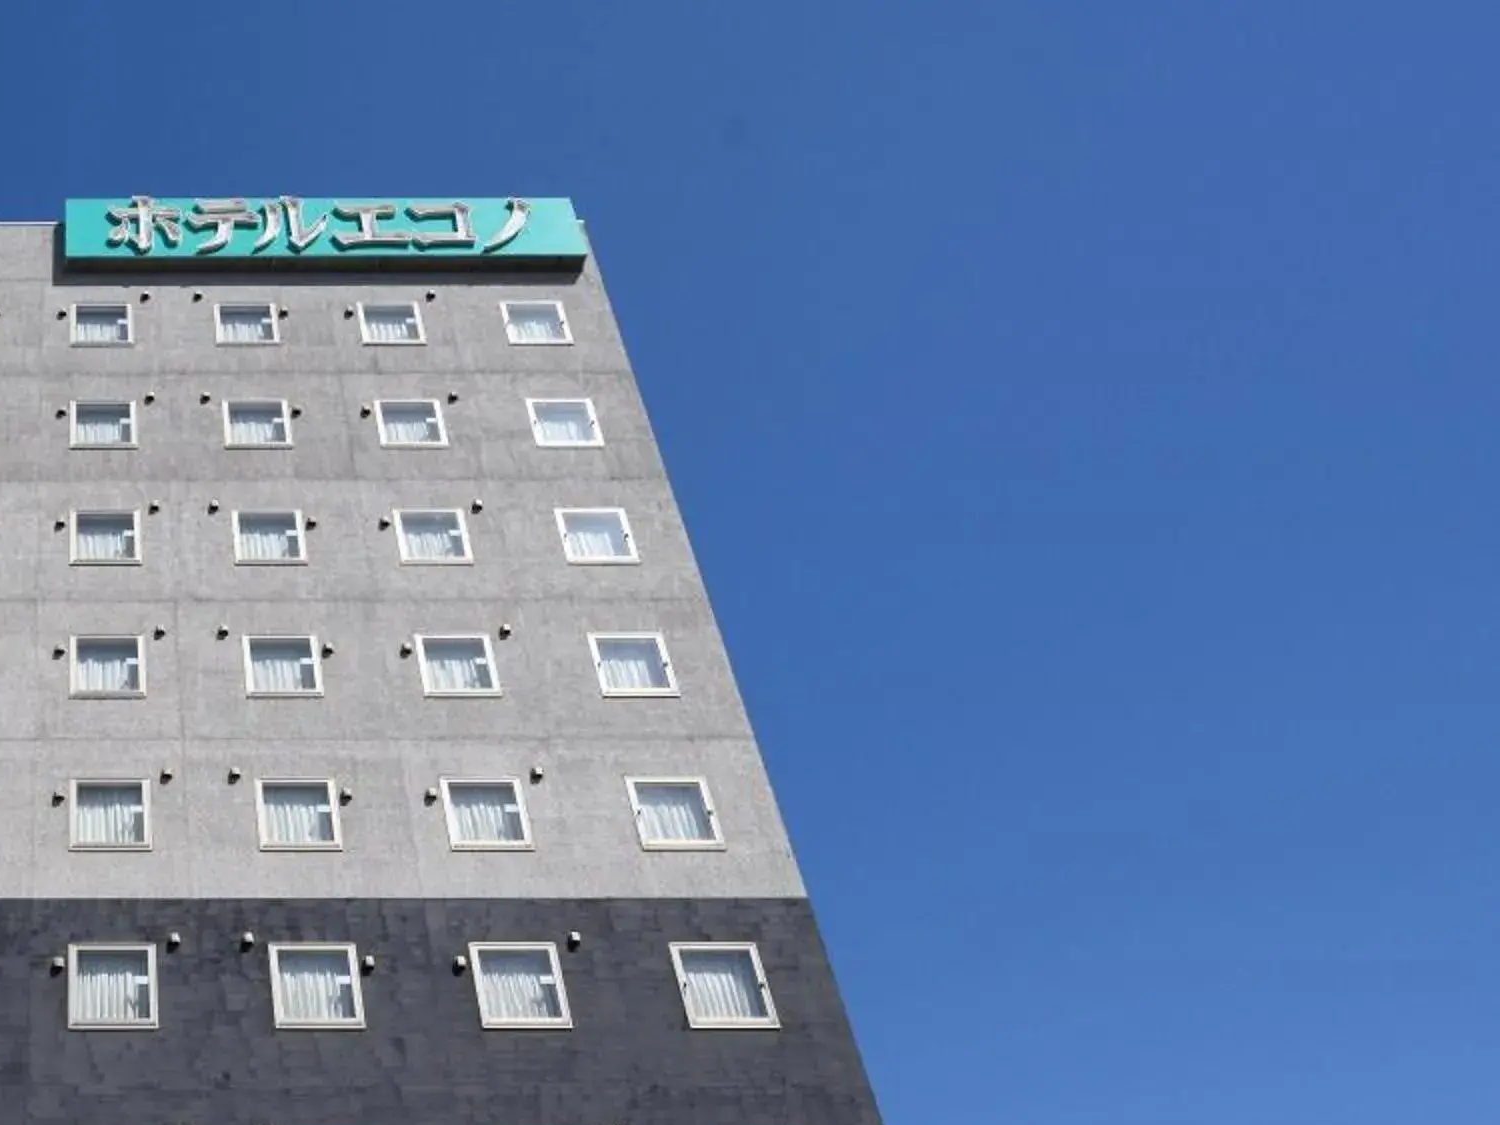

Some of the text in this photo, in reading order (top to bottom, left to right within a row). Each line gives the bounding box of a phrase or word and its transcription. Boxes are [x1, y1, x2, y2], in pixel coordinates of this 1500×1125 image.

[106, 197, 532, 253] ホテルエコノ
